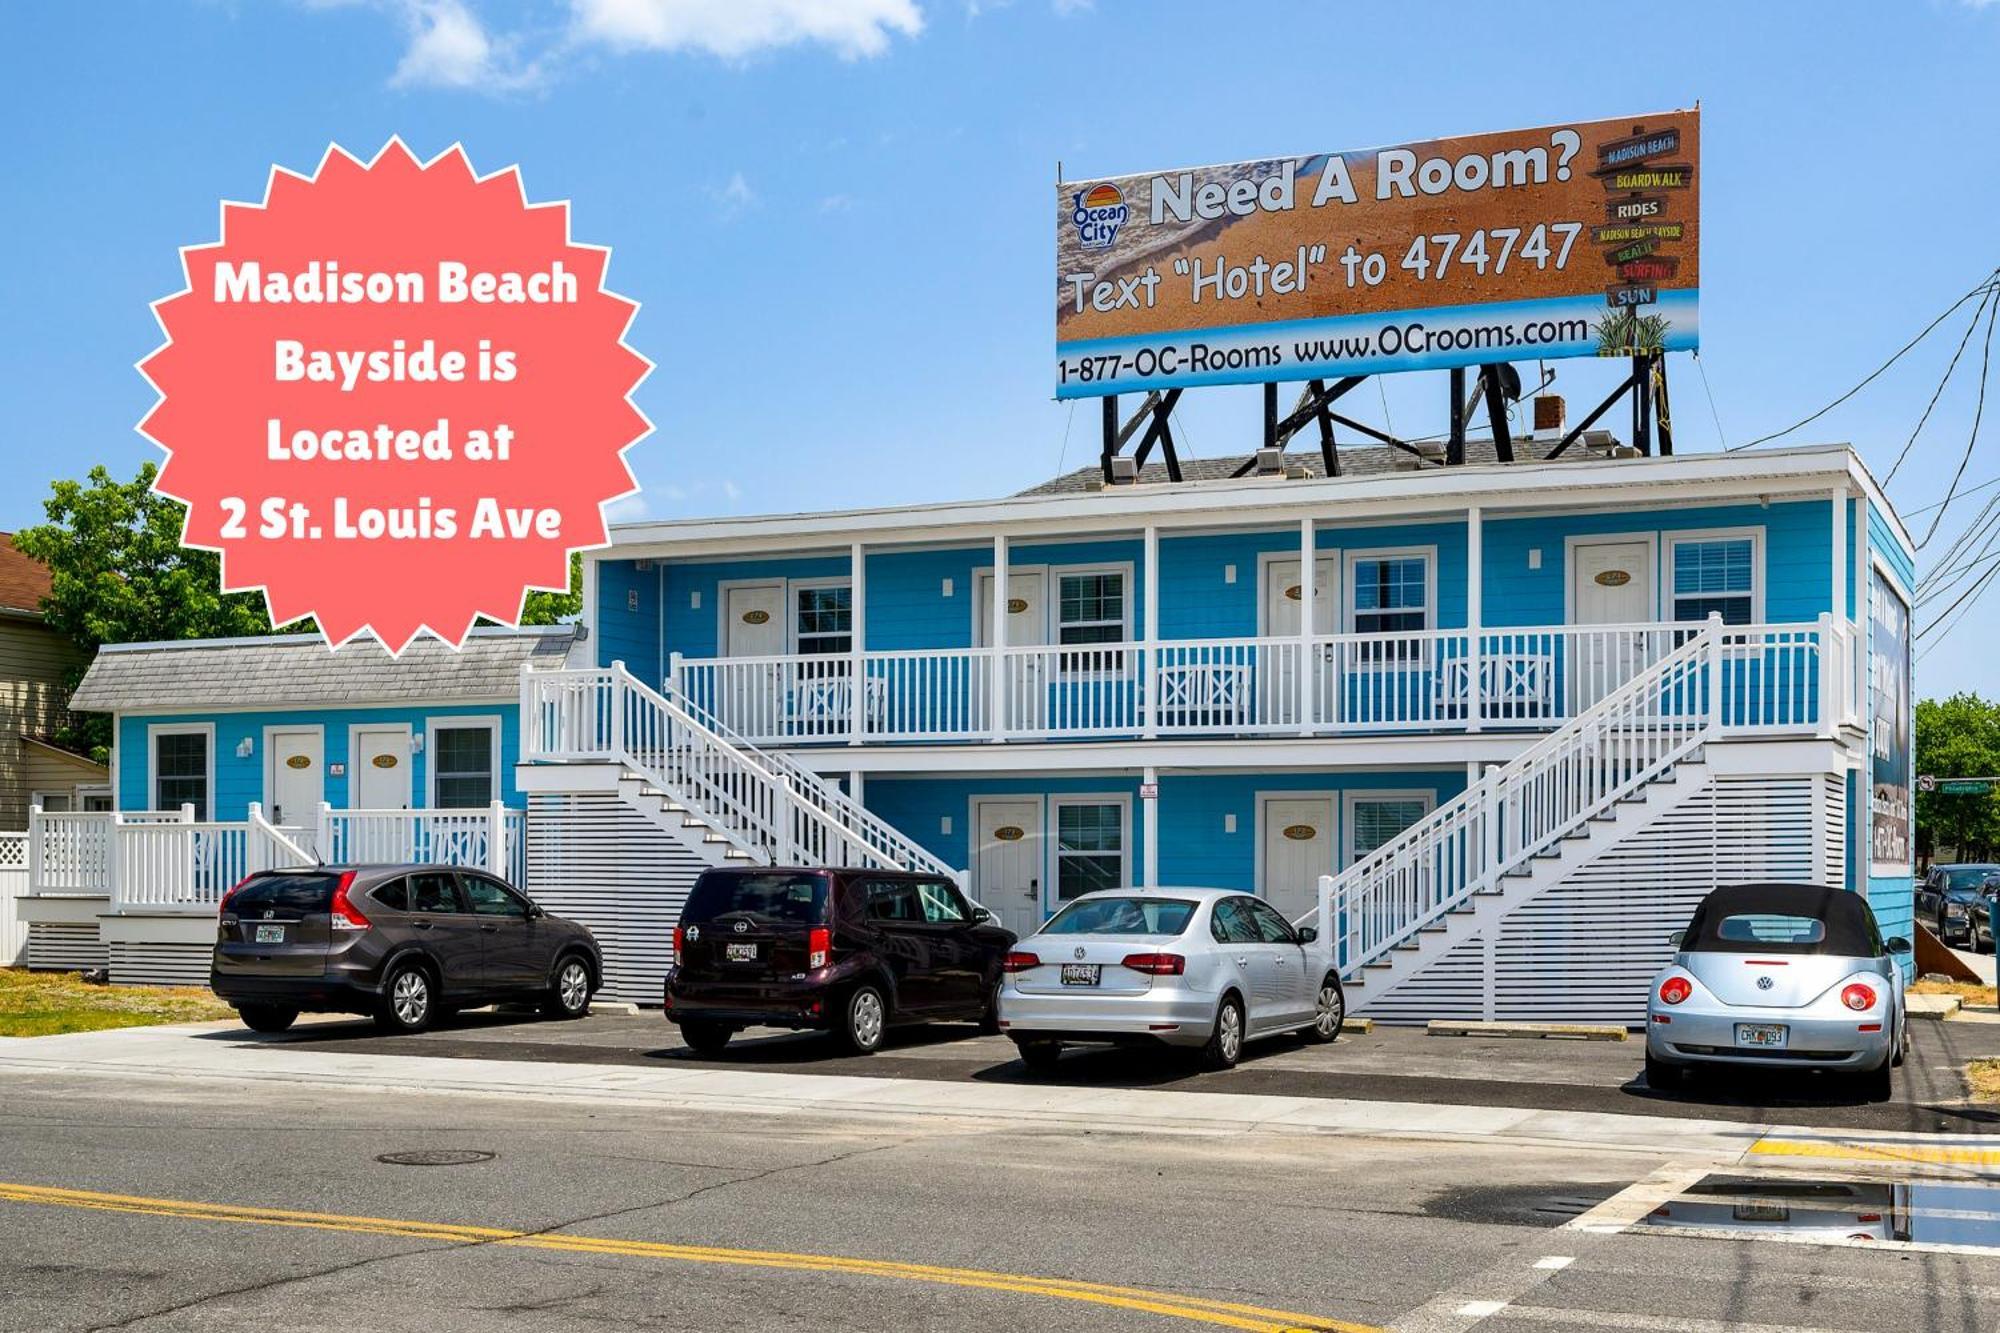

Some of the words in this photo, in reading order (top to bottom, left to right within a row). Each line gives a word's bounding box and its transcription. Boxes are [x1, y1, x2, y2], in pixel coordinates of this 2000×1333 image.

[1608, 142, 1646, 165] MADISON
[1648, 135, 1676, 155] BEACH
[1151, 160, 1296, 225] Need
[1311, 155, 1359, 208] A
[1376, 128, 1582, 201] Room?
[1616, 171, 1683, 189] BOARDWALK
[1073, 206, 1128, 225] Ocean
[1618, 201, 1659, 218] RIDES
[1081, 222, 1118, 244] City
[1065, 267, 1161, 313] Text
[1340, 246, 1387, 288] to
[1401, 222, 1583, 281] 474747
[1617, 288, 1651, 305] SUN
[1058, 343, 1281, 384] 1-877-OC-Rooms
[1294, 319, 1588, 362] www.OCrooms.com
